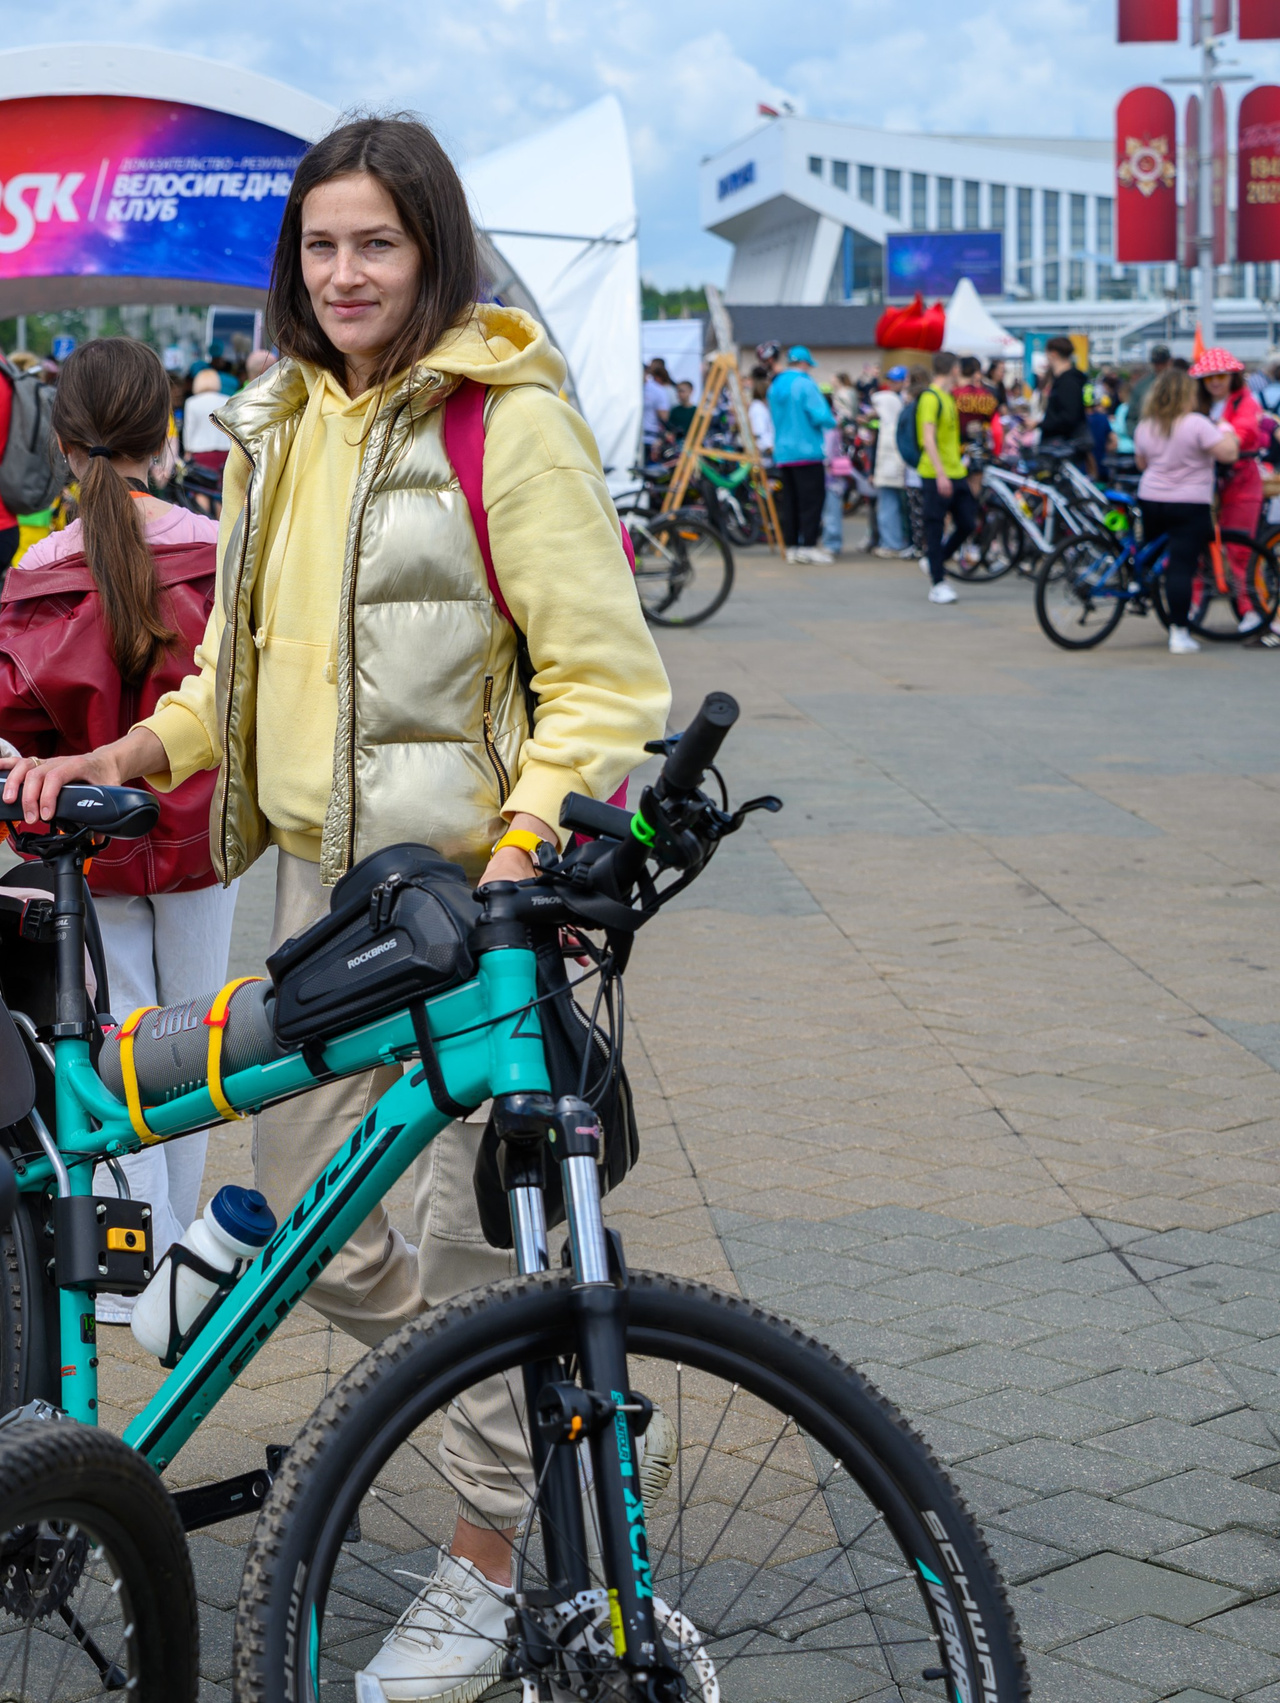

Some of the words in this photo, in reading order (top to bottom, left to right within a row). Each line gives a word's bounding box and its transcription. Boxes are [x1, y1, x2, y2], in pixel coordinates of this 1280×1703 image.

[106, 197, 180, 222] КЛУБ
[113, 172, 293, 202] ВЕЛОСИПЕДНЫ
[347, 938, 398, 970] ROCKBROS
[151, 1000, 198, 1040] JBL
[260, 1106, 379, 1276] FUJI
[623, 1487, 653, 1599] XCM
[284, 1560, 307, 1703] SMAR
[921, 1510, 999, 1703] SCHWAL
